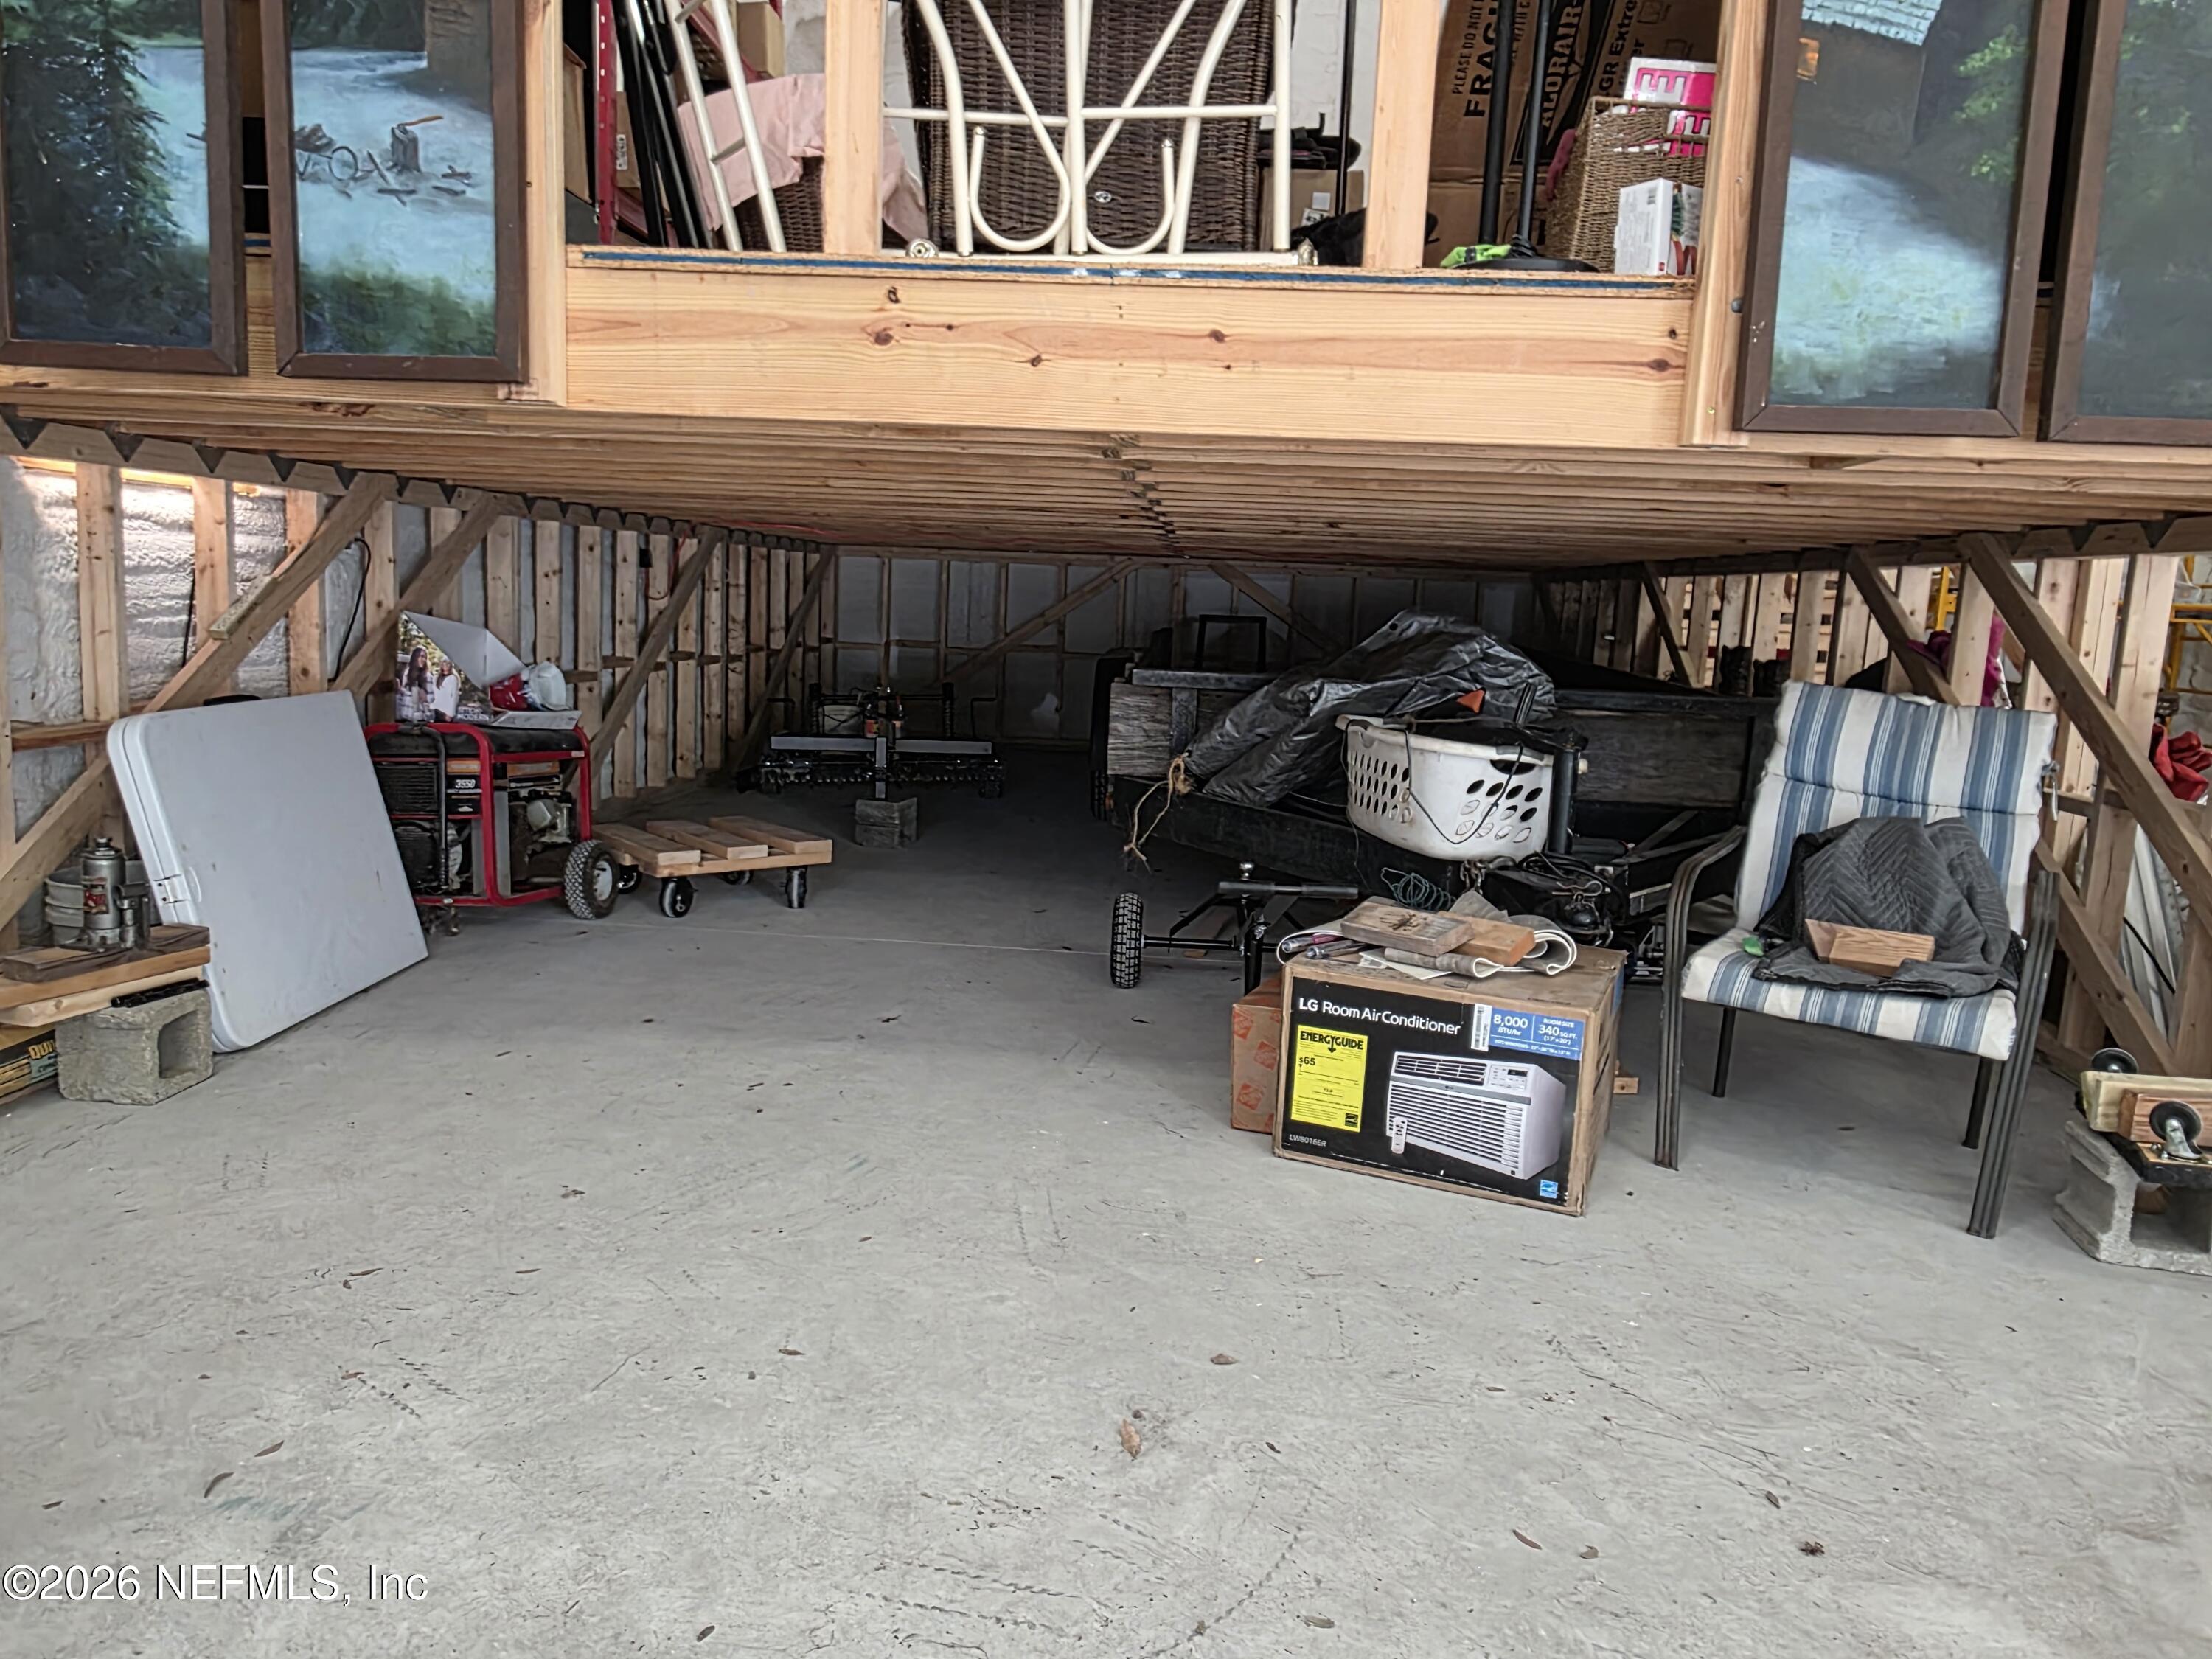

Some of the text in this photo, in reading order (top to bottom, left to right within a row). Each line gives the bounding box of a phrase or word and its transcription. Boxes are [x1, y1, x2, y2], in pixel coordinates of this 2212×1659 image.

[1467, 5, 1483, 29] NOT
[1462, 32, 1476, 49] DO
[1453, 52, 1472, 94] PLEASE
[455, 779, 476, 788] 3550
[1299, 998, 1461, 1035] LG Room Air Conditioner
[1494, 1014, 1528, 1029] 8,000
[1543, 1018, 1562, 1026] ROOM
[1498, 1026, 1522, 1036] BTU/hr
[1538, 1025, 1559, 1036] 340
[1300, 1030, 1364, 1051] ENERGYGUIDE
[1299, 1056, 1316, 1066] $65
